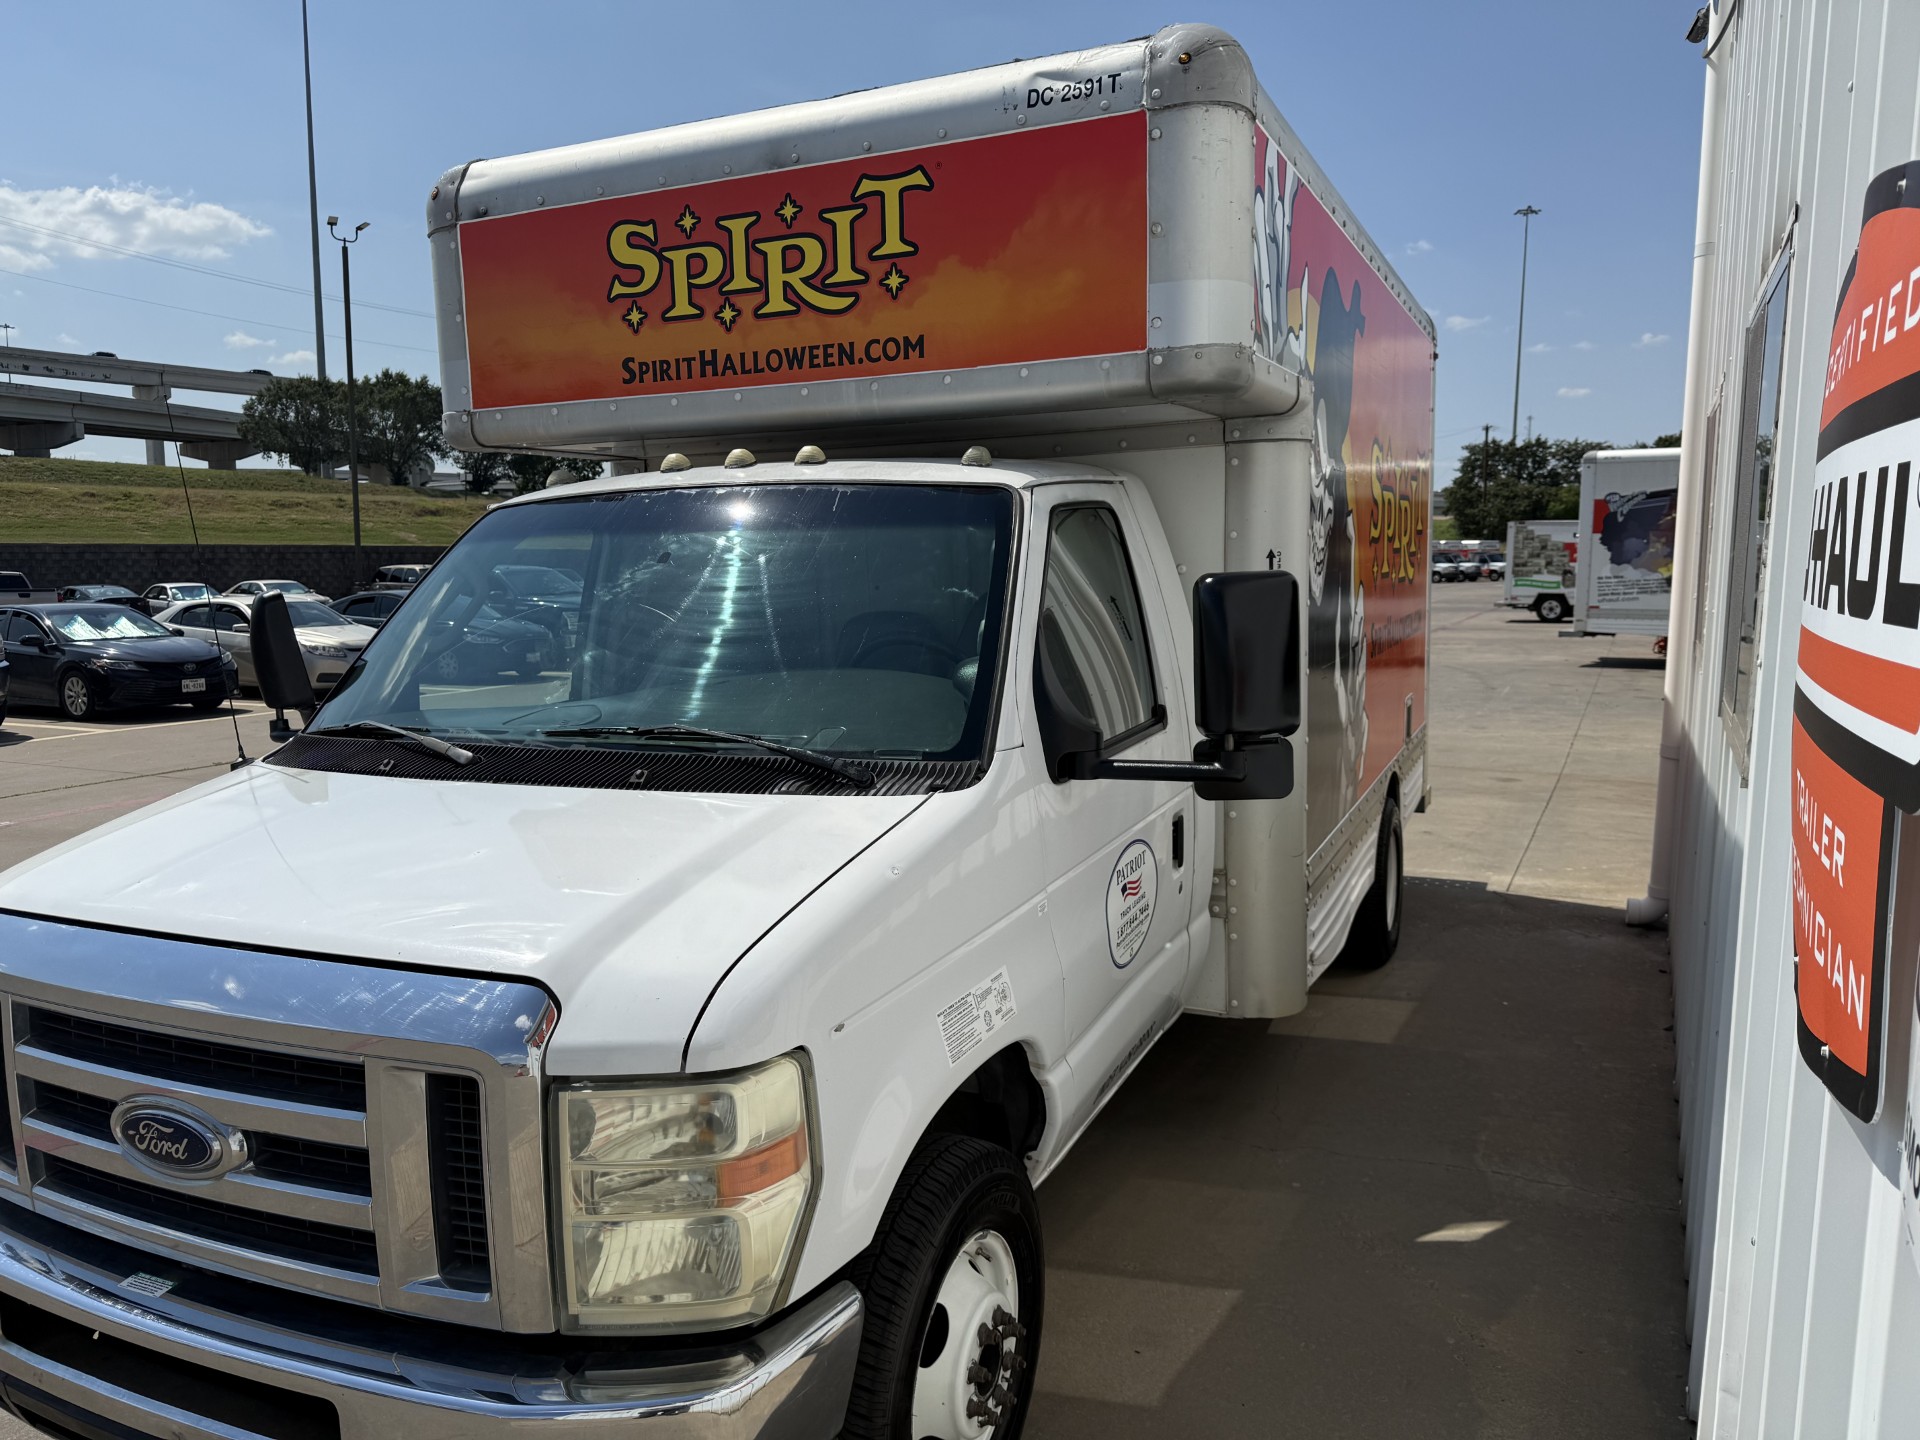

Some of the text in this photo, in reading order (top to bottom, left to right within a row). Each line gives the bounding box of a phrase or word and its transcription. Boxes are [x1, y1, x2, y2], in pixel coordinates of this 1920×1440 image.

[1027, 86, 1054, 109] DC
[607, 165, 934, 322] SPIRIT
[1369, 437, 1426, 584] SPIRIT
[1116, 850, 1146, 886] PATRIOT
[1797, 768, 1846, 888] TRAILER
[128, 1120, 188, 1160] Ford
